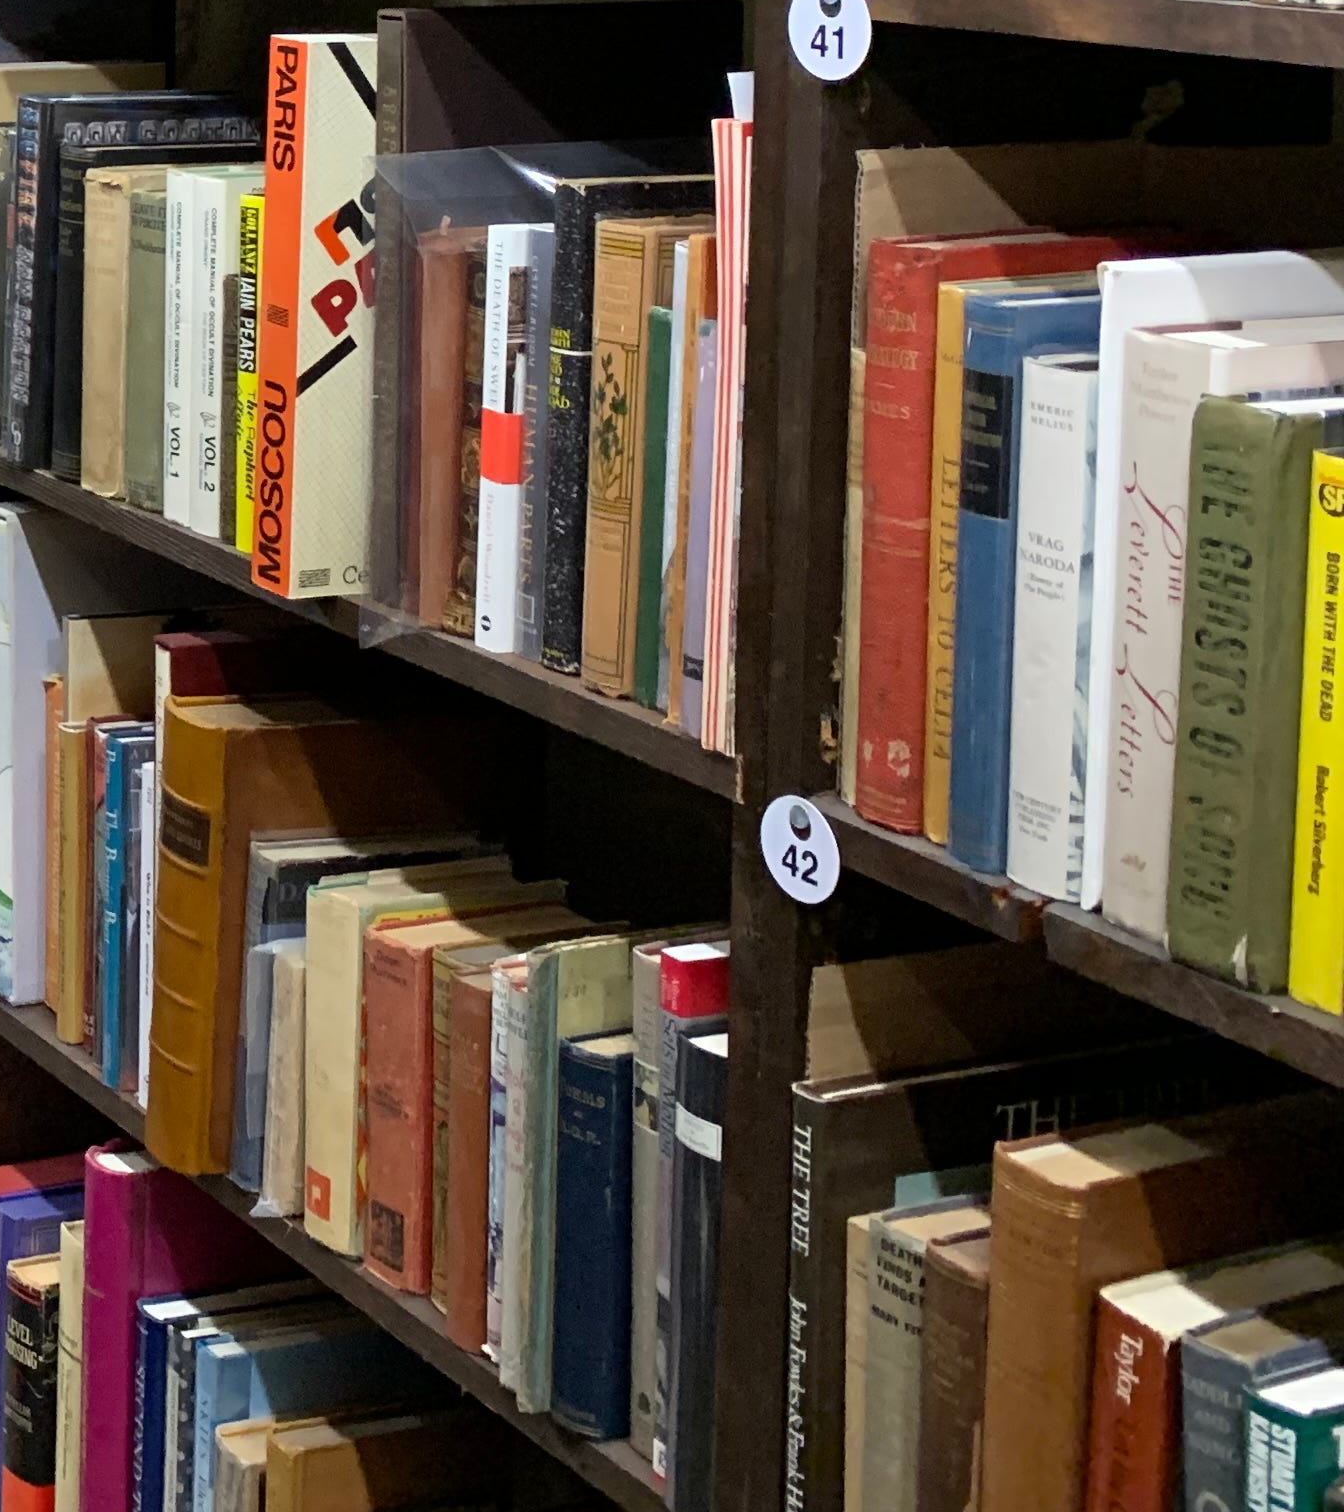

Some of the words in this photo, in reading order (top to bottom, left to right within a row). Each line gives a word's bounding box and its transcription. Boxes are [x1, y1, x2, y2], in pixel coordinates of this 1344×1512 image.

[810, 24, 844, 59] 41
[273, 44, 300, 174] PARIS
[173, 250, 182, 284] MANUAL
[208, 256, 217, 292] MANUAL
[493, 241, 504, 276] THE
[239, 276, 257, 309] IAIN
[492, 279, 504, 332] DEATH
[172, 302, 181, 336] OCCULT
[207, 309, 216, 345] OCCULT
[238, 315, 257, 371] PEARS
[169, 425, 181, 467] VOL.
[204, 435, 217, 477] VOL.
[522, 382, 540, 491] HUMAN
[203, 480, 217, 492] 2
[256, 380, 288, 586] MOSCOU
[518, 500, 535, 585] PARTS
[938, 455, 961, 596] LETTERS
[1027, 531, 1066, 553] VRAG
[1019, 546, 1076, 575] NARODA
[1324, 551, 1341, 596] BORN
[1168, 564, 1187, 606] THE
[935, 606, 955, 651] TO
[1322, 599, 1338, 643] WITH
[1320, 645, 1336, 674] THE
[1318, 679, 1335, 722] DEAD
[1312, 764, 1331, 813] Robert
[781, 845, 820, 886] 42
[1307, 819, 1327, 896] Silverberg
[792, 1123, 812, 1185] THE
[790, 1187, 811, 1257] TREE
[881, 1236, 923, 1266] DEATH
[788, 1292, 808, 1343] John
[871, 1302, 899, 1329] MARY
[1112, 1332, 1144, 1407] Taylor
[1270, 1423, 1297, 1508] STUART
